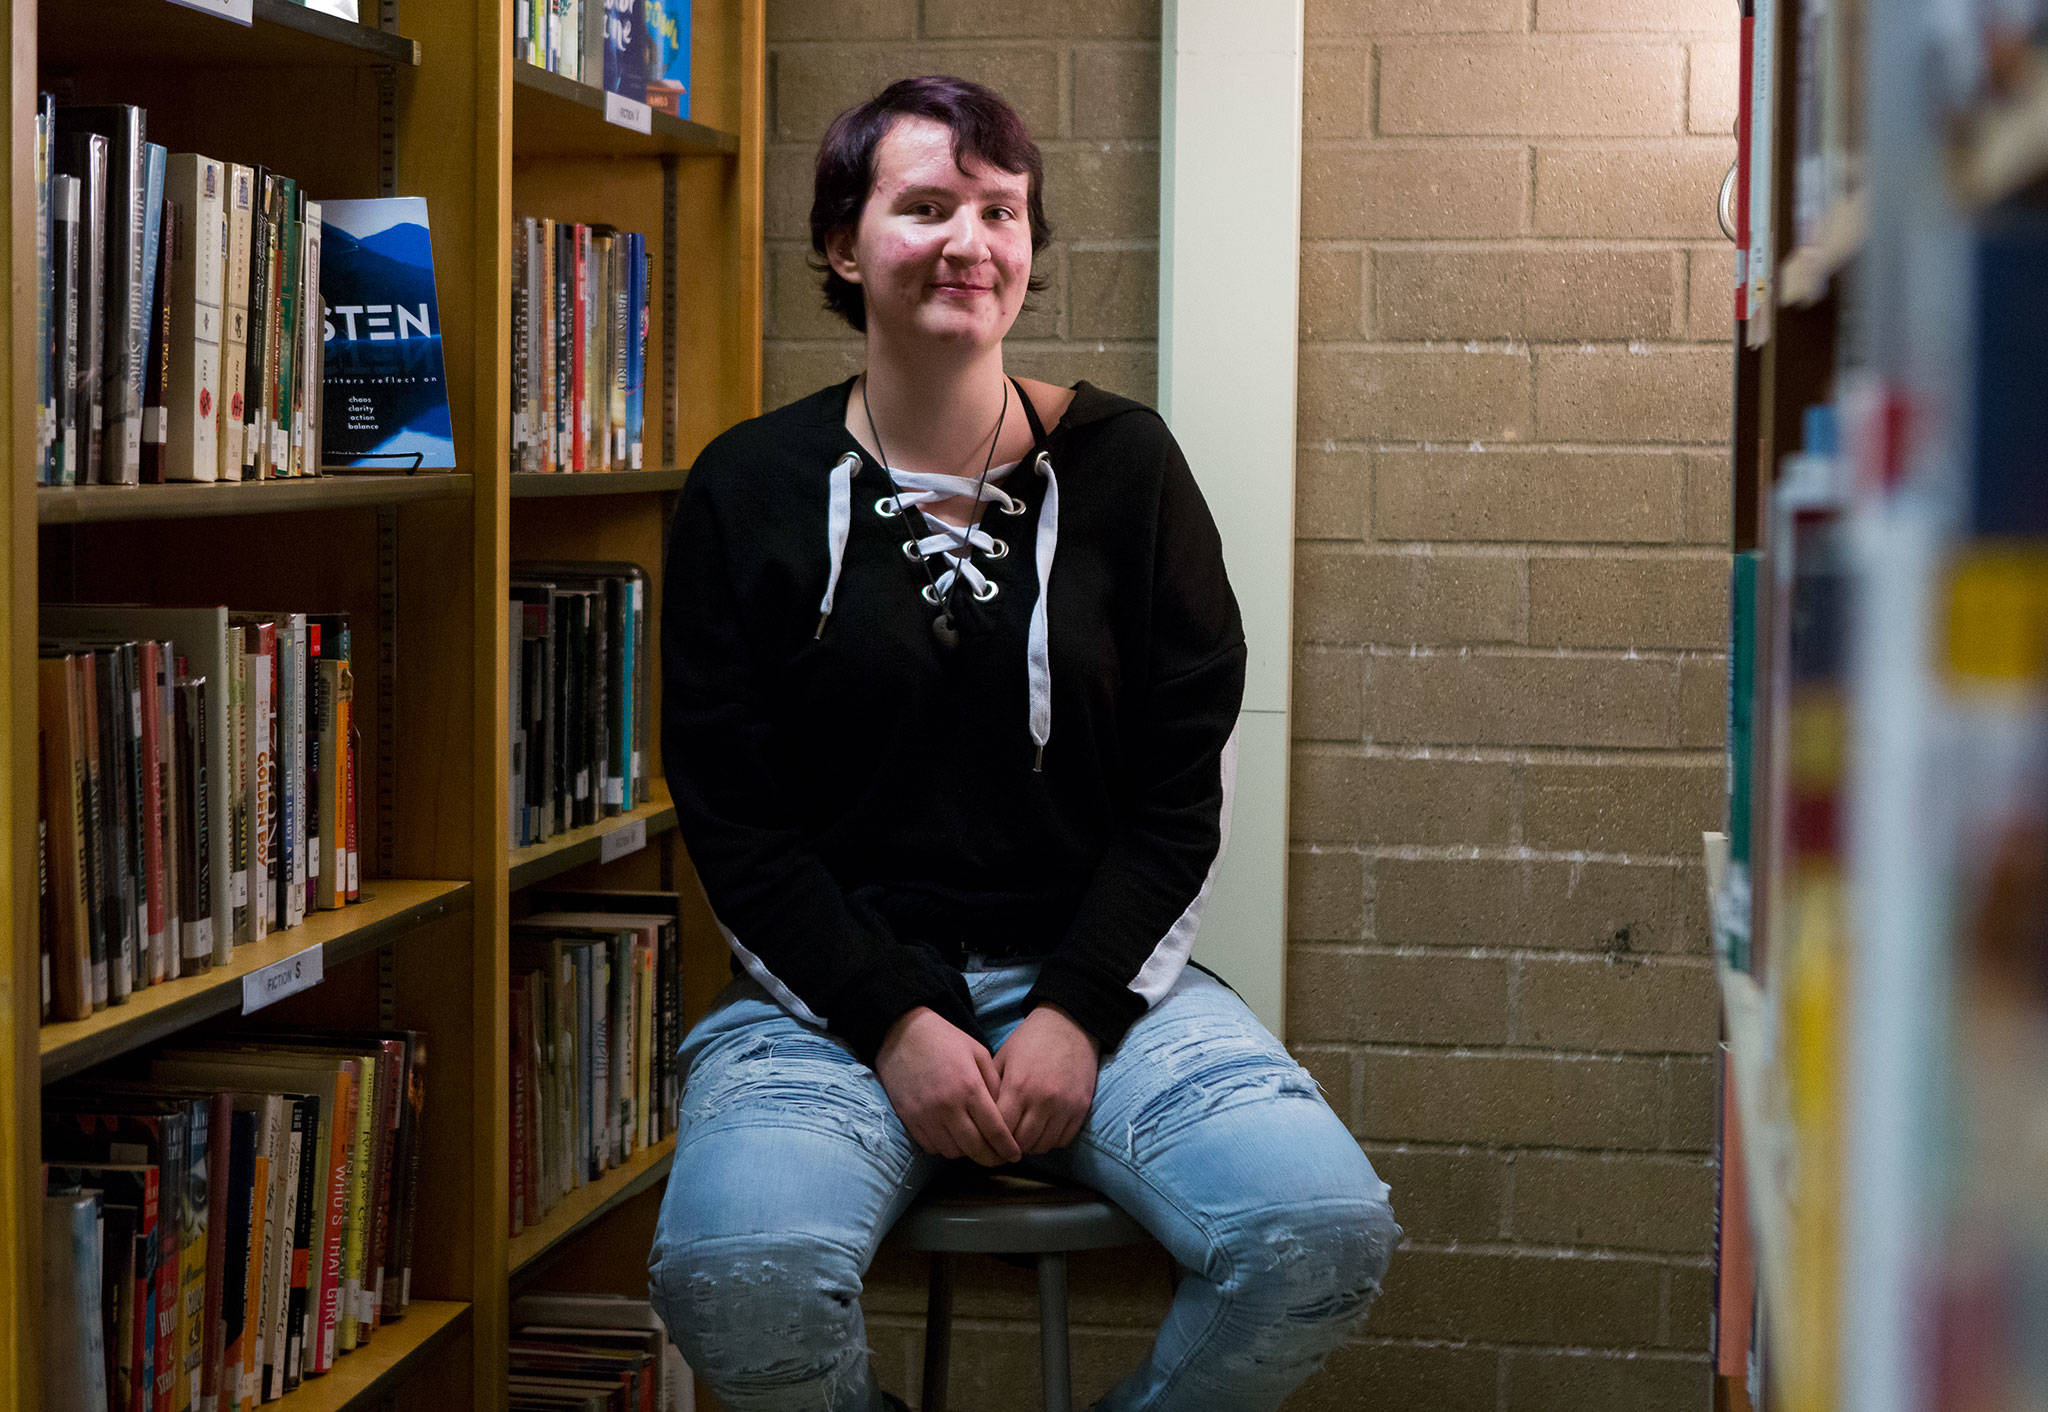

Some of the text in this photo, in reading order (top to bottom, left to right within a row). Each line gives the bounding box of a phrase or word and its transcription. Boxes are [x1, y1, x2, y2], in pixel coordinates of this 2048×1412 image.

[161, 305, 171, 392] THE PEARL
[617, 292, 628, 392] DARK ENERGY
[348, 396, 372, 404] chaos
[371, 376, 416, 384] reflect
[424, 375, 438, 384] on
[347, 422, 379, 430] balance
[348, 404, 374, 414] clarity
[239, 705, 247, 755] BITTER
[258, 752, 269, 827] GOLDEN
[199, 767, 210, 912] Chanda's Wars
[240, 815, 248, 866] SWEET
[257, 832, 269, 868] BOY
[267, 961, 301, 991] FICTION S
[325, 1165, 345, 1330] WHO'S THAT GIRL
